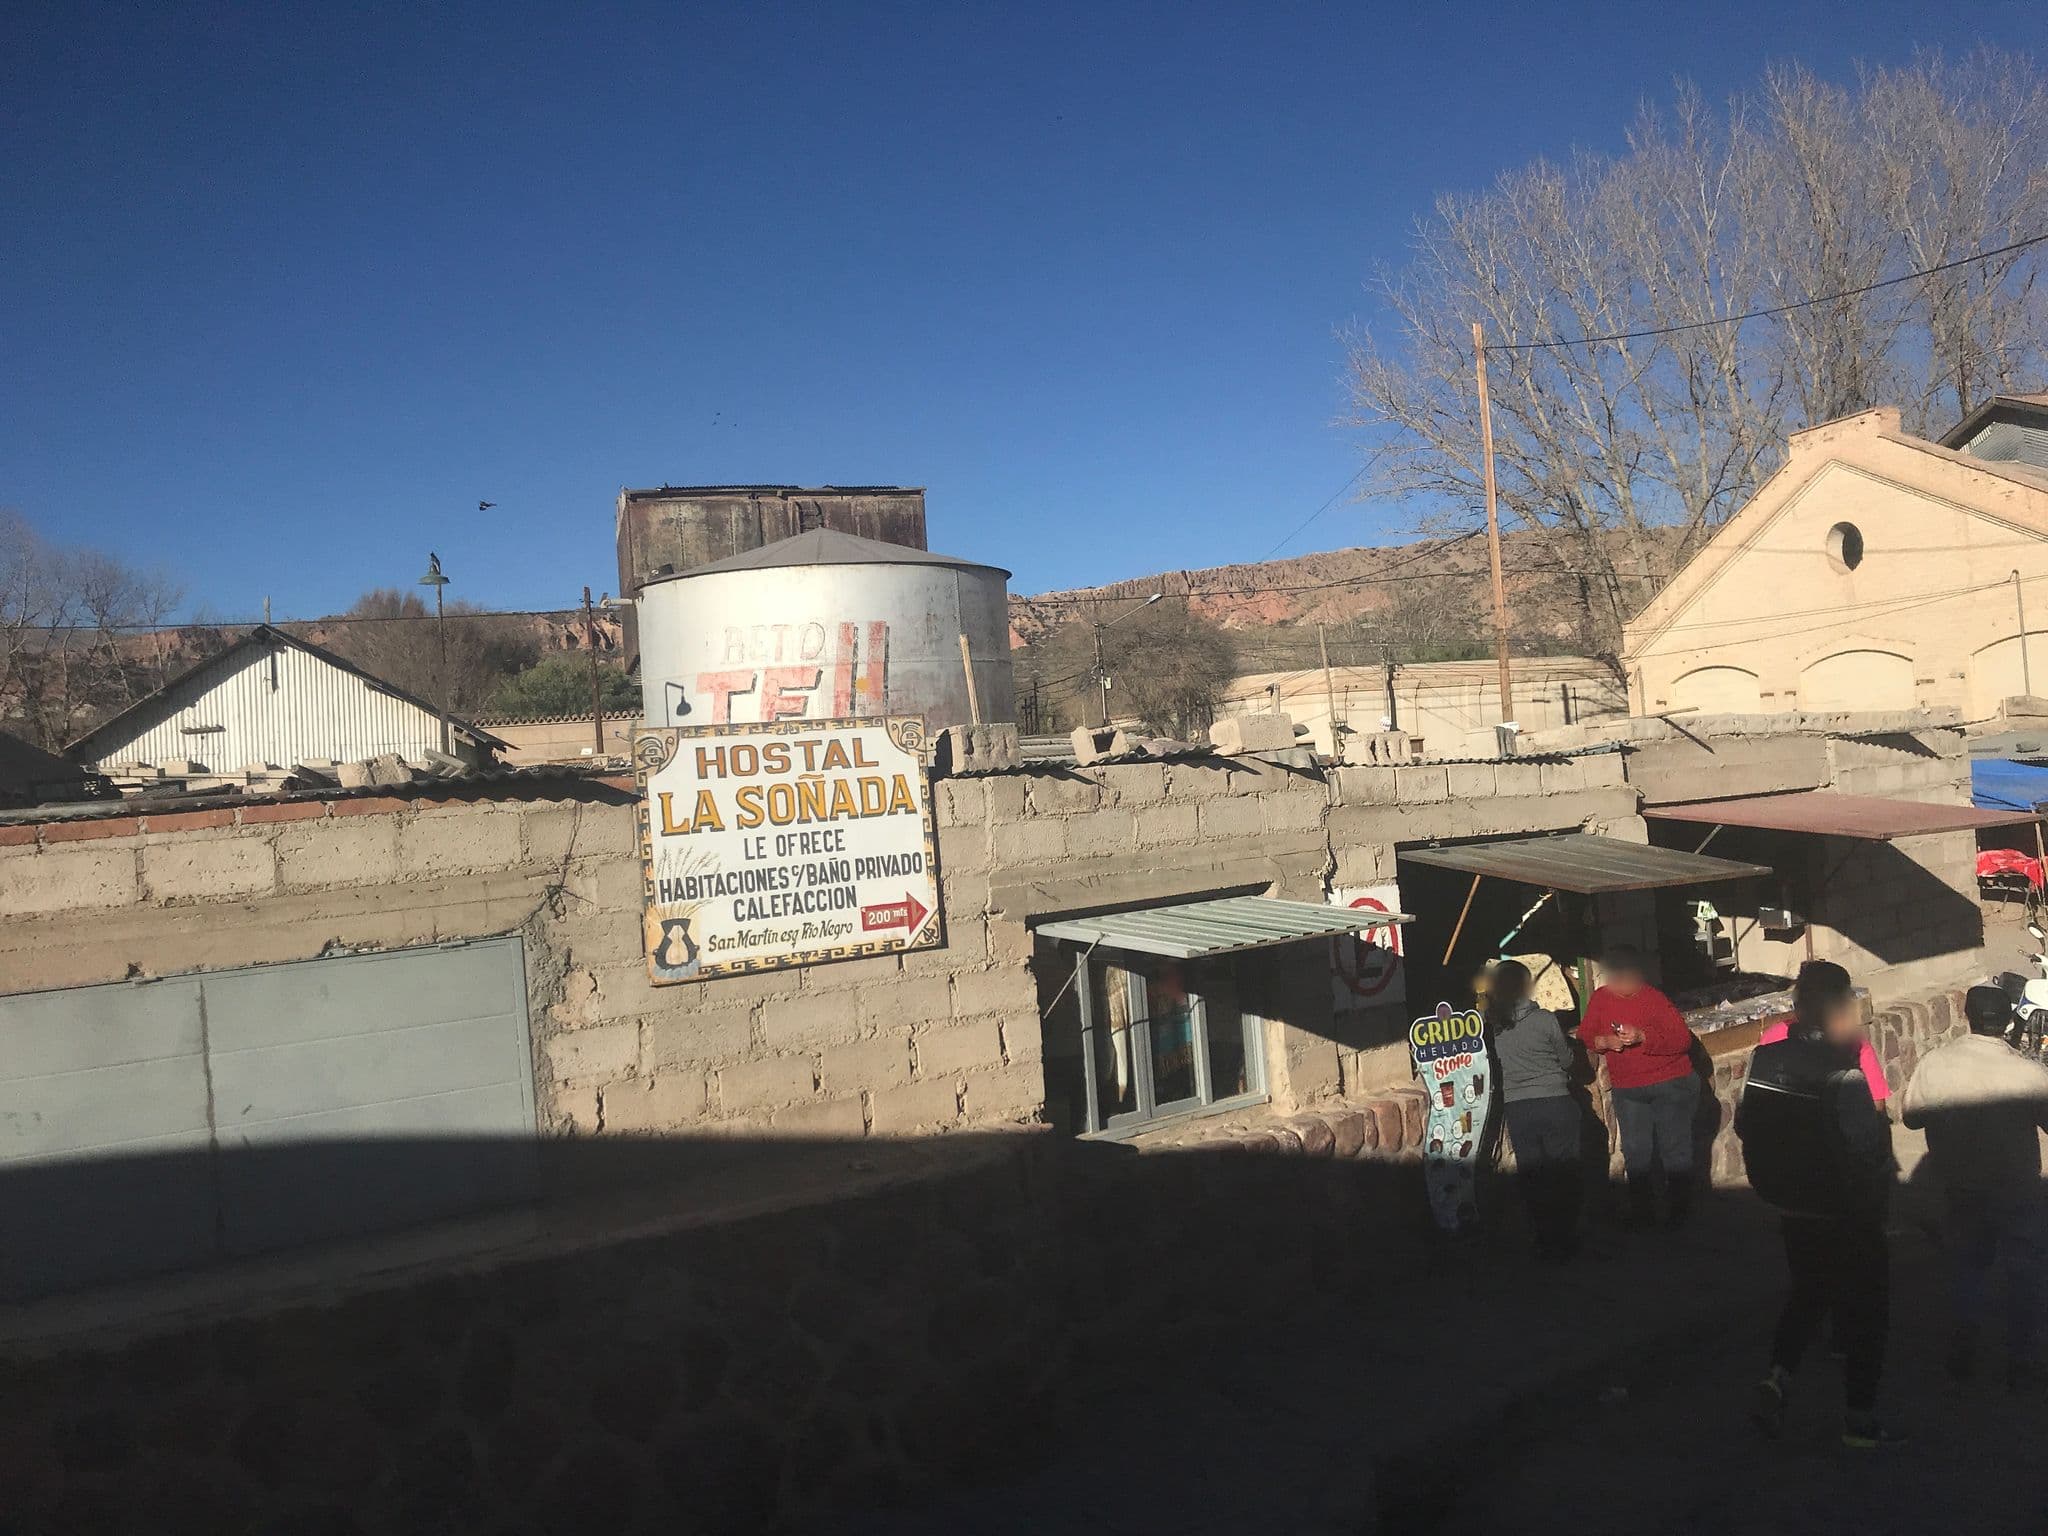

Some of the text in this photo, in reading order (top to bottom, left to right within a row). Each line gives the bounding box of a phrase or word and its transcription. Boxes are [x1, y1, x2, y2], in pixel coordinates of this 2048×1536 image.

[695, 737, 880, 780] HOSTAL
[658, 773, 918, 837] LA SOÑADA
[743, 828, 846, 861] LE OFRECE
[658, 865, 790, 904] HABITACIONES
[855, 851, 923, 882] PRIVADO
[733, 885, 858, 923] CALEFACCION
[868, 906, 909, 926] 200 mts
[708, 935, 736, 953] San
[780, 929, 800, 949] esq
[819, 919, 853, 941] Negro
[1413, 1014, 1481, 1046] GRIDO
[1420, 1039, 1479, 1059] HELADO
[1433, 1053, 1473, 1080] Store
